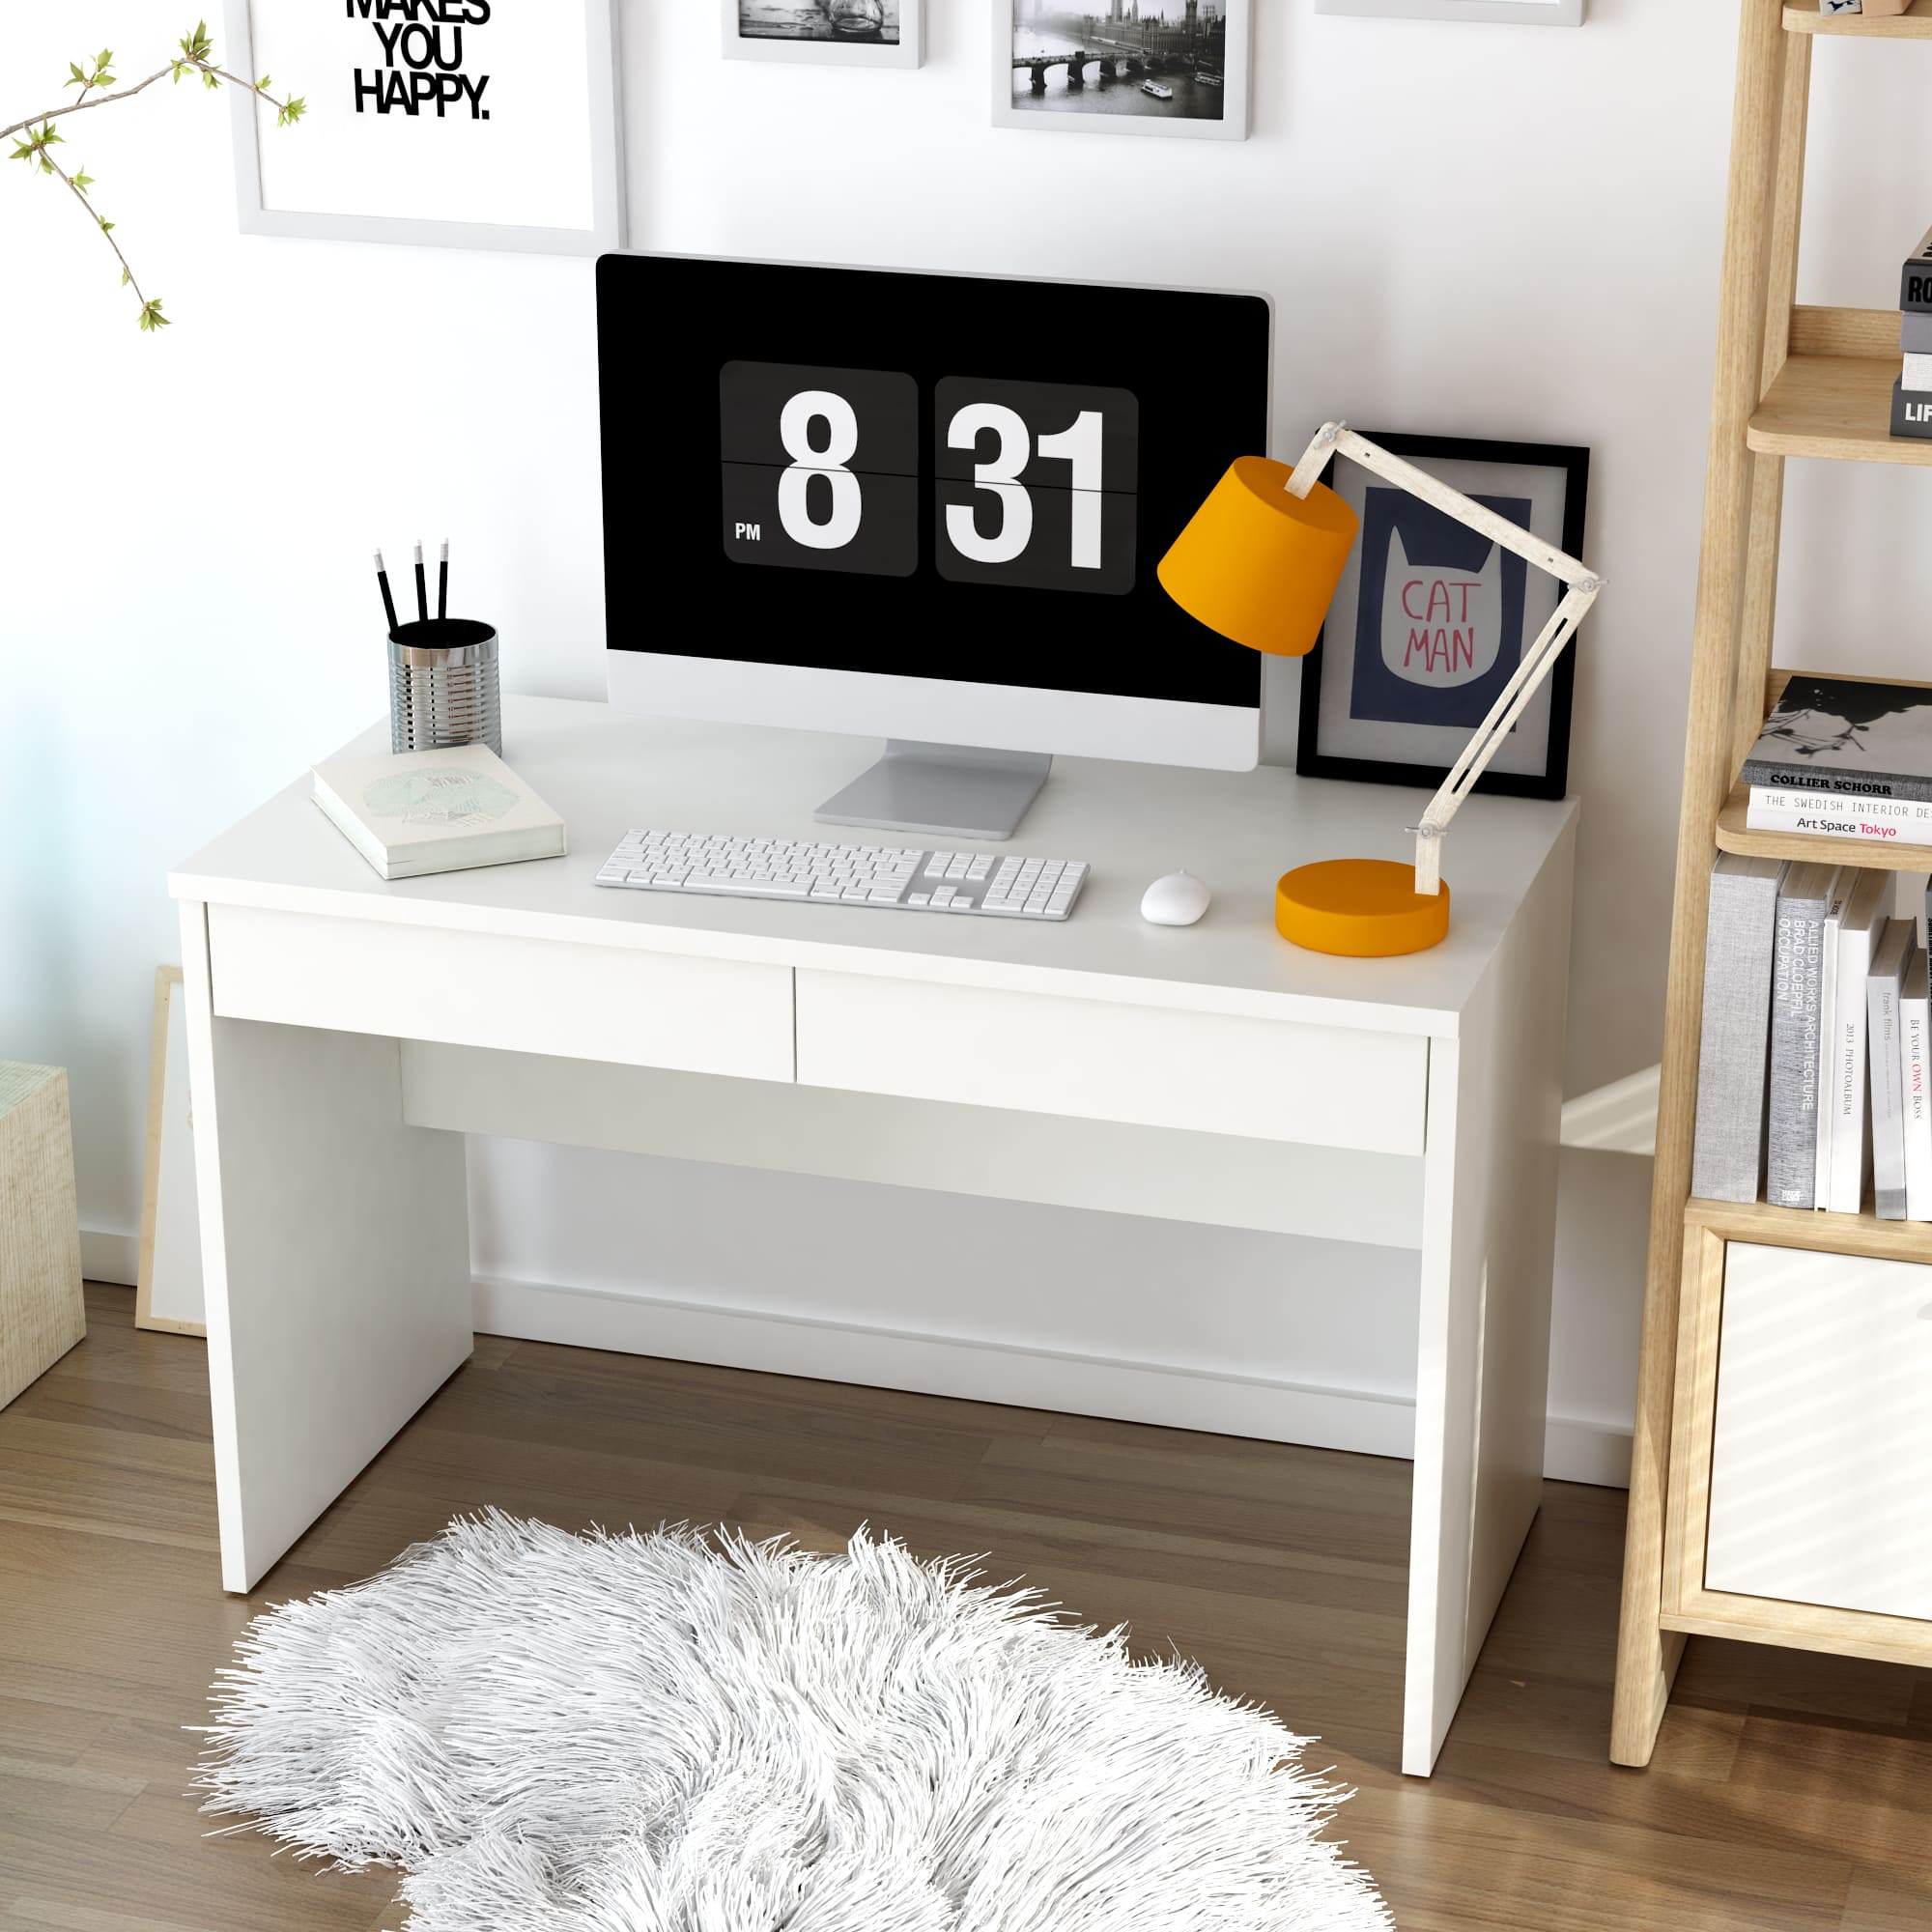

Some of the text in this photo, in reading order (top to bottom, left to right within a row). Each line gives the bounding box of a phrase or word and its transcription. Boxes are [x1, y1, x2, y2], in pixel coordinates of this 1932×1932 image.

[372, 21, 463, 71] YOU
[354, 68, 491, 121] HAPPY.
[778, 390, 1103, 569] 8 31
[734, 522, 761, 541] PM
[1402, 580, 1482, 623] CAT
[1403, 627, 1474, 672] MAN
[1770, 774, 1892, 795] COLLIER SCHORR
[1765, 795, 1932, 819] THE SWEDISH INTERIOR DE
[1797, 817, 1897, 838] Art Space Tokyo
[1793, 920, 1805, 955] BRAD
[1776, 918, 1791, 1002] OCCUPATION
[1802, 920, 1819, 1112] ALLIED WORKS ARCHITECTURE
[1882, 991, 1892, 1016] frank
[1883, 1018, 1893, 1041] films
[1910, 1033, 1920, 1061] YOUR
[1843, 1023, 1855, 1115] 2013 PHOTOALBUM
[1911, 1063, 1922, 1093] OWN
[1913, 1094, 1922, 1120] BOSS
